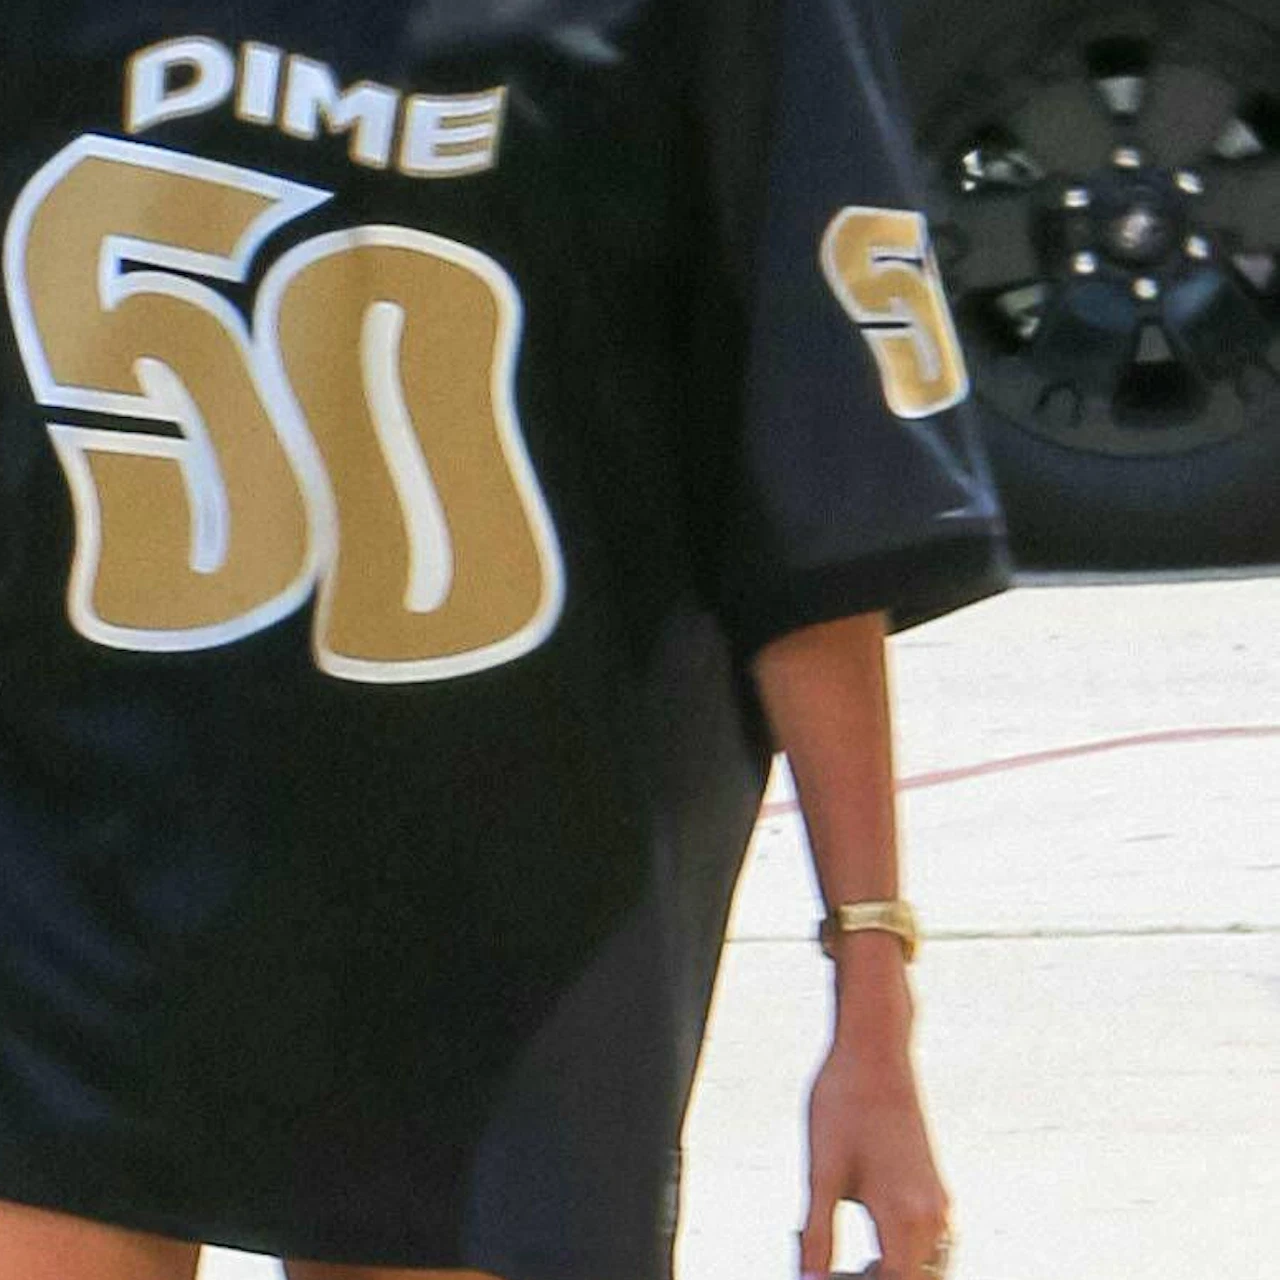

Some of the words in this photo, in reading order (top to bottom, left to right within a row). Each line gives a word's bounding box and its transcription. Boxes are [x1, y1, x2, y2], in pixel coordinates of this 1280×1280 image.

[126, 35, 510, 178] DIME
[4, 133, 565, 682] 50
[819, 205, 970, 419] 5
